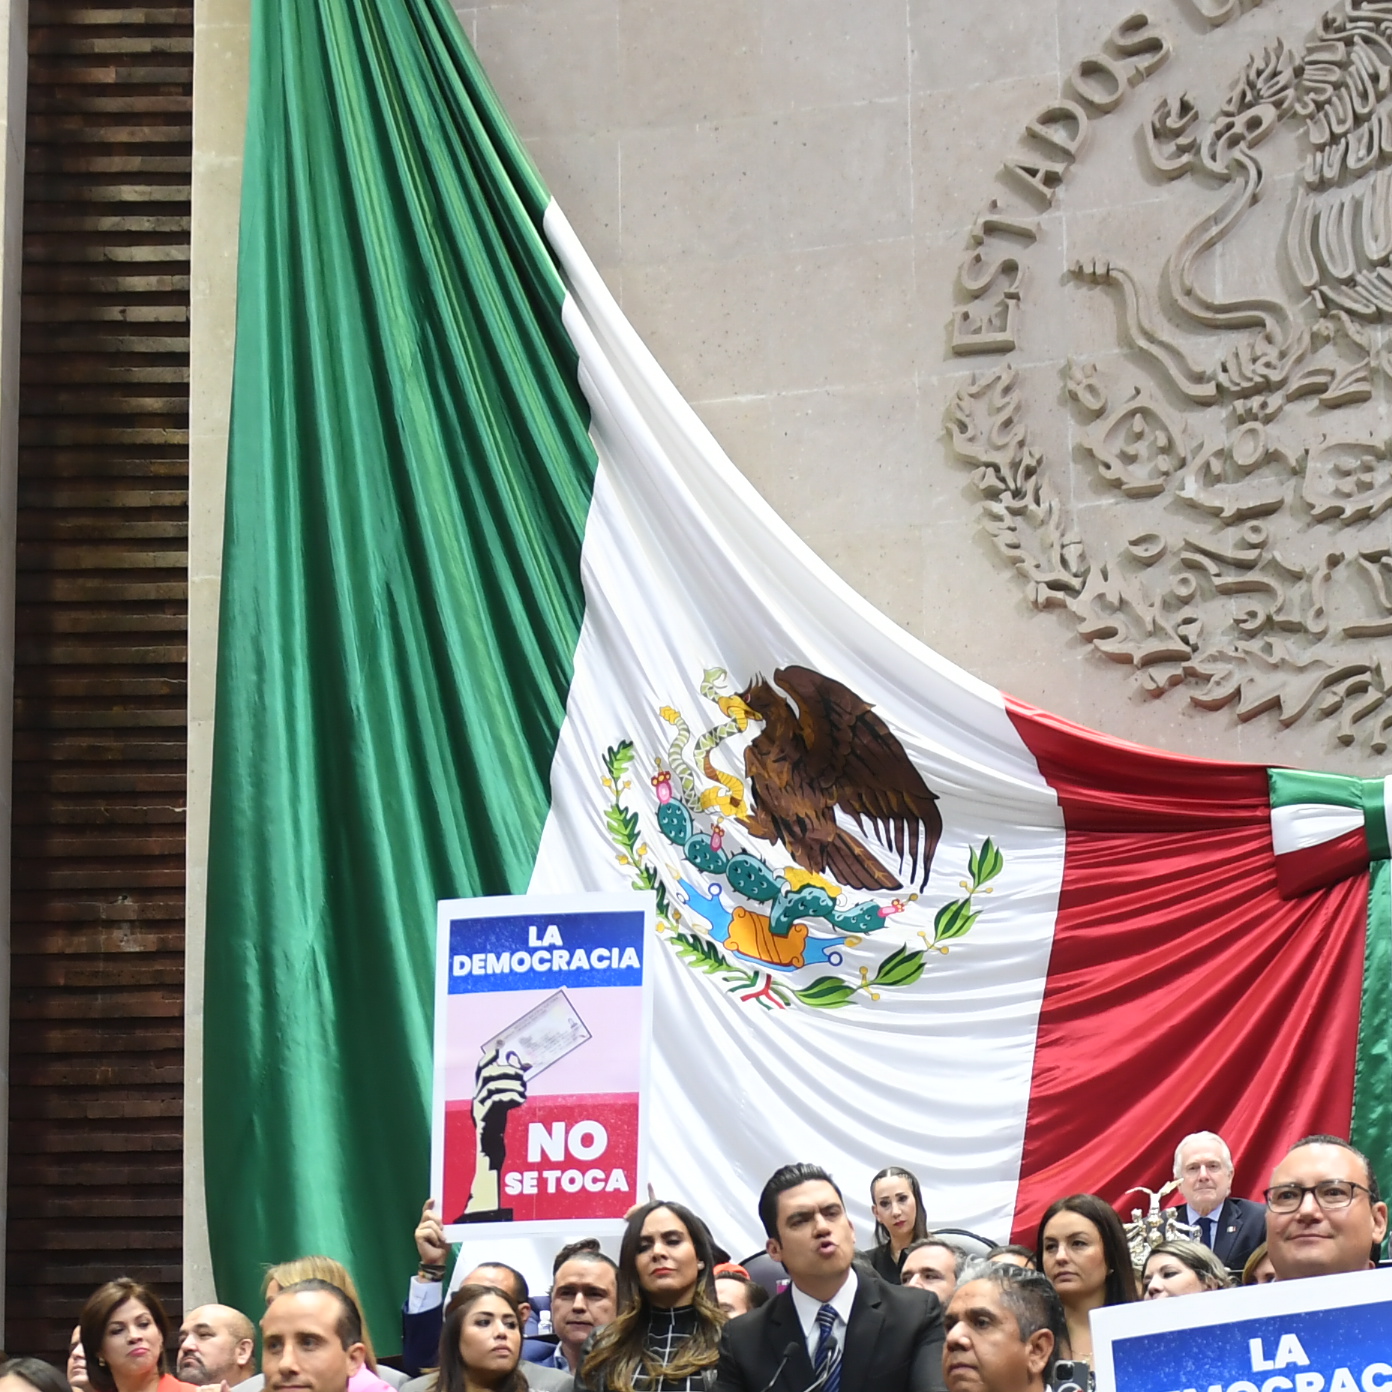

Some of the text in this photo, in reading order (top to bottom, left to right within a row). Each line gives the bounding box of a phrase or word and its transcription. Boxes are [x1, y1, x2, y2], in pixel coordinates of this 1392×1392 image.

[952, 12, 1173, 356] ESTADOS
[529, 925, 563, 947] LA
[453, 948, 640, 976] DEMOCRACIA
[528, 1120, 607, 1162] NO
[505, 1169, 629, 1195] SE TOCA
[1250, 1334, 1310, 1372] LA
